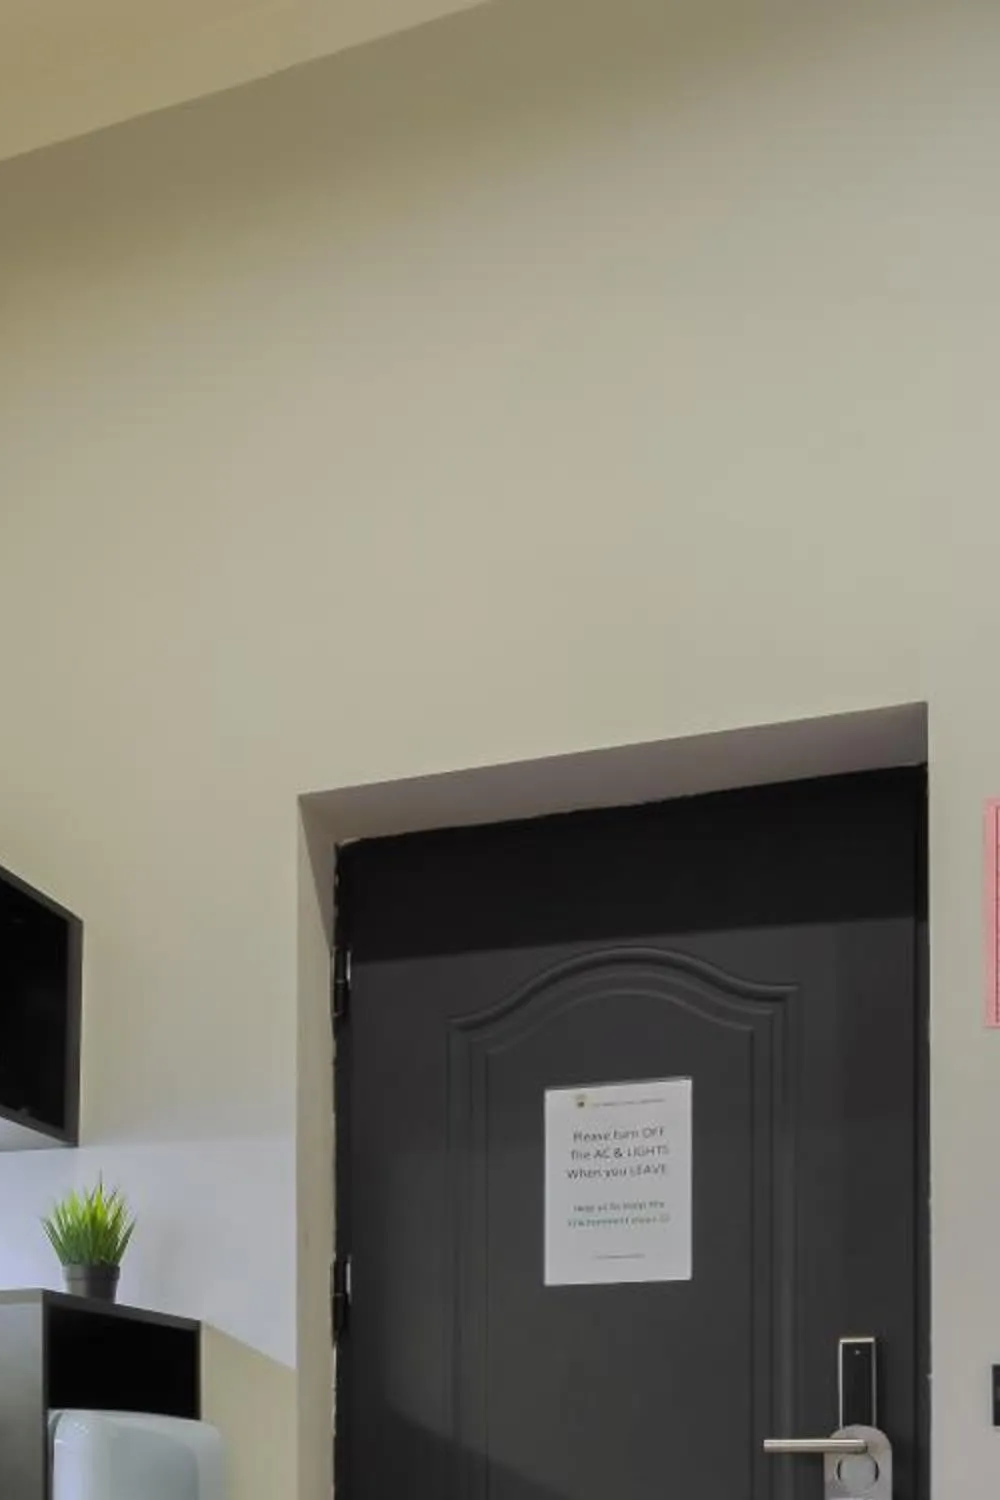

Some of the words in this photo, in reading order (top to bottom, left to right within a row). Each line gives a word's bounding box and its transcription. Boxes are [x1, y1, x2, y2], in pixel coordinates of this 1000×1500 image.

[573, 1130, 611, 1143] Please
[613, 1128, 640, 1140] turn
[642, 1126, 665, 1139] OFF
[593, 1148, 611, 1160] AC
[613, 1147, 624, 1159] &
[627, 1145, 670, 1158] LIGHTS
[604, 1167, 628, 1179] you
[630, 1163, 667, 1177] LEAVE
